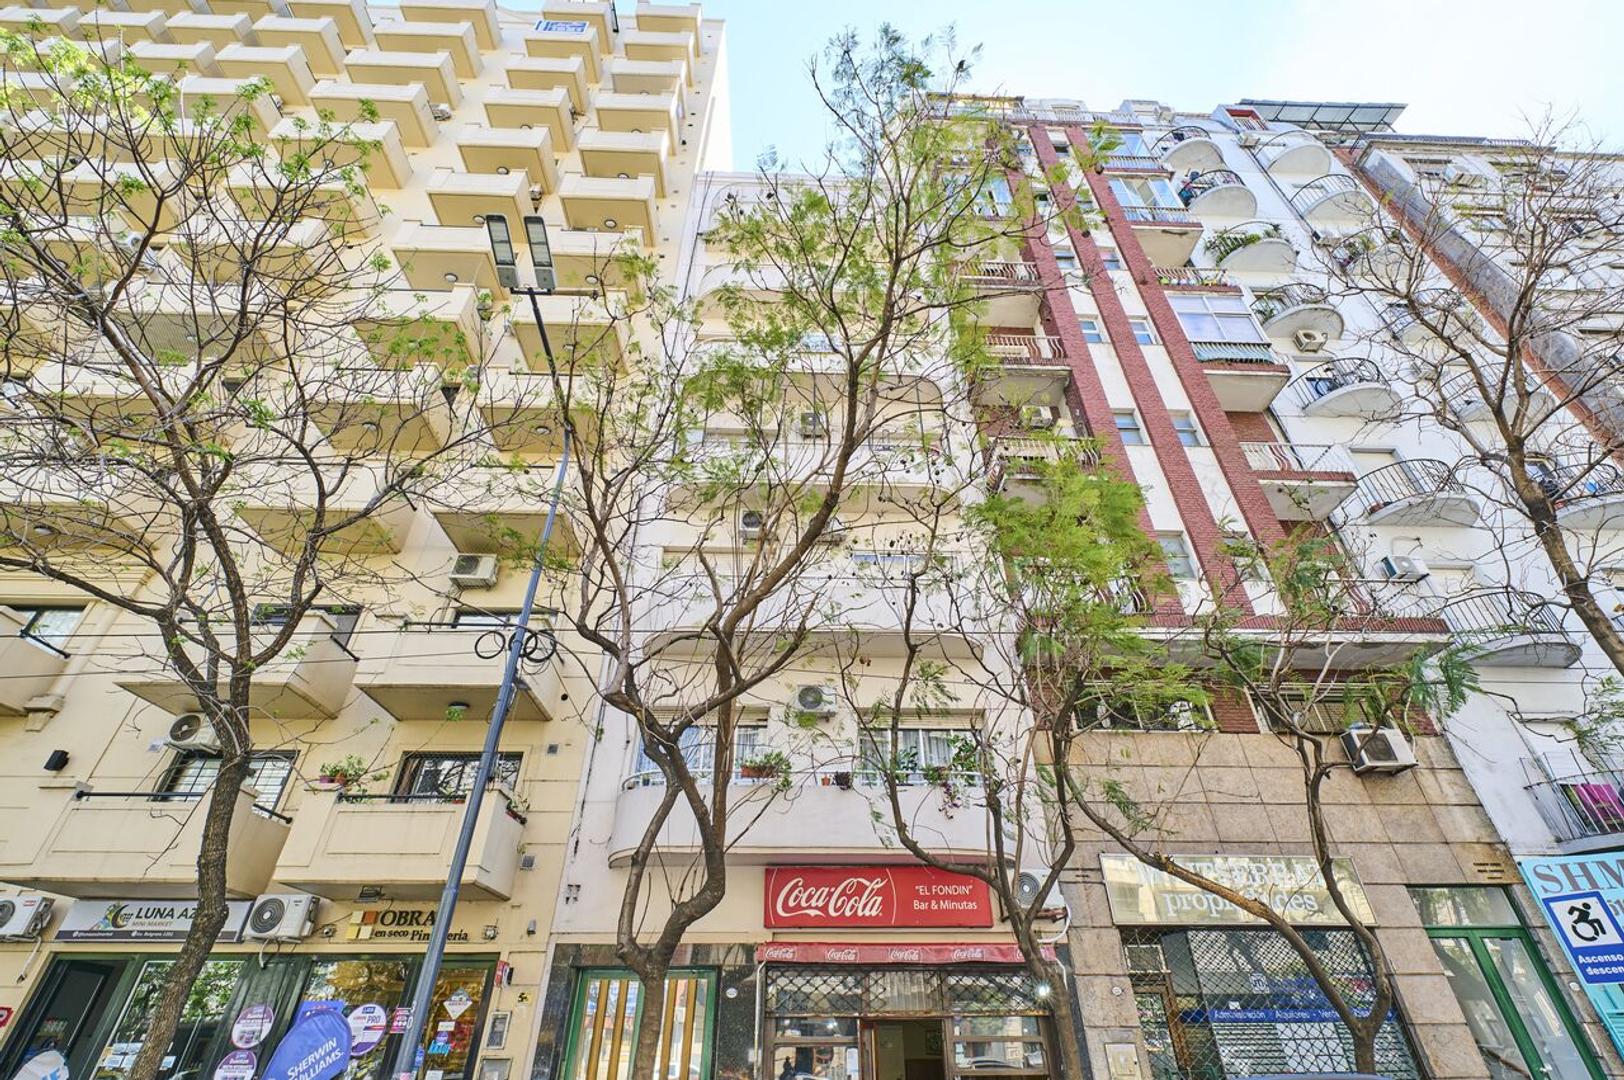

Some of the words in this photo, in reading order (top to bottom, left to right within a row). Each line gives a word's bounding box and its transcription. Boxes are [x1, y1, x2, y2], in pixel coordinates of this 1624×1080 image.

[776, 877, 889, 918] Coca-Cola
[913, 900, 929, 910] Bar
[931, 900, 939, 910] &
[940, 900, 978, 911] Minutas
[135, 907, 175, 919] LUNA
[148, 920, 174, 928] MARKET
[374, 930, 386, 938] en
[388, 929, 409, 937] seco
[410, 929, 469, 941] Pinería
[287, 1036, 337, 1079] SHERWIN
